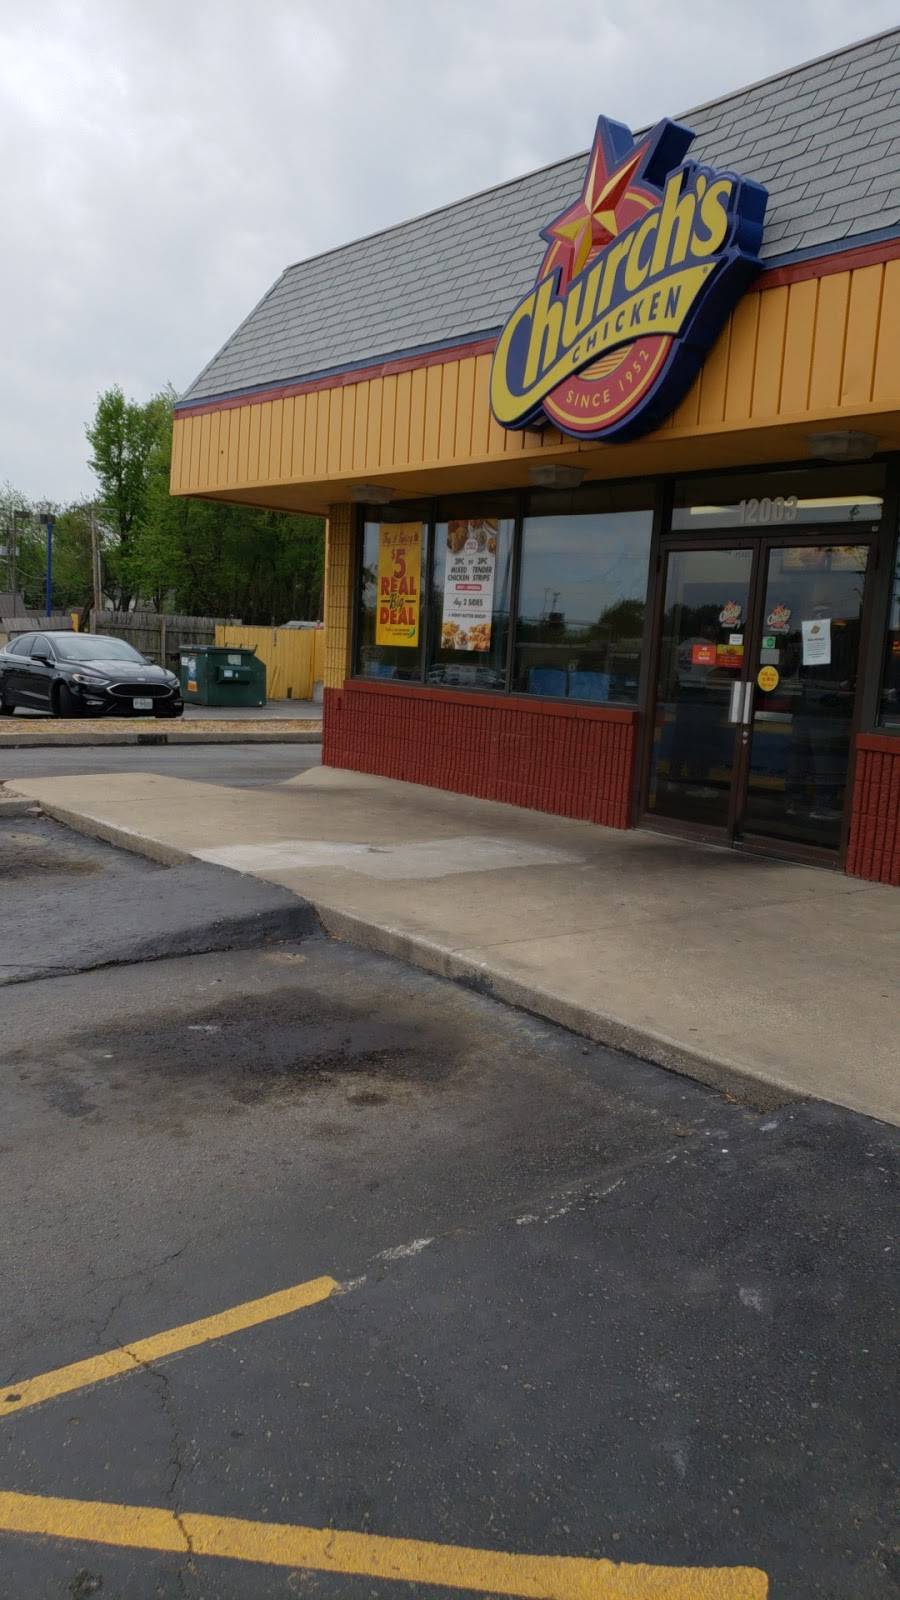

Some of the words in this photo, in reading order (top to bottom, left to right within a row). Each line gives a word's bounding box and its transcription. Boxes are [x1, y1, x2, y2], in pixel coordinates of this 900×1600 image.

[490, 172, 733, 422] Church's
[571, 285, 682, 363] CHICKEN
[566, 390, 611, 408] SINCE
[618, 349, 650, 392] 1952
[737, 496, 799, 523] 12003
[391, 549, 406, 578] $5
[381, 577, 416, 595] REAL
[380, 607, 415, 625] DEAL
